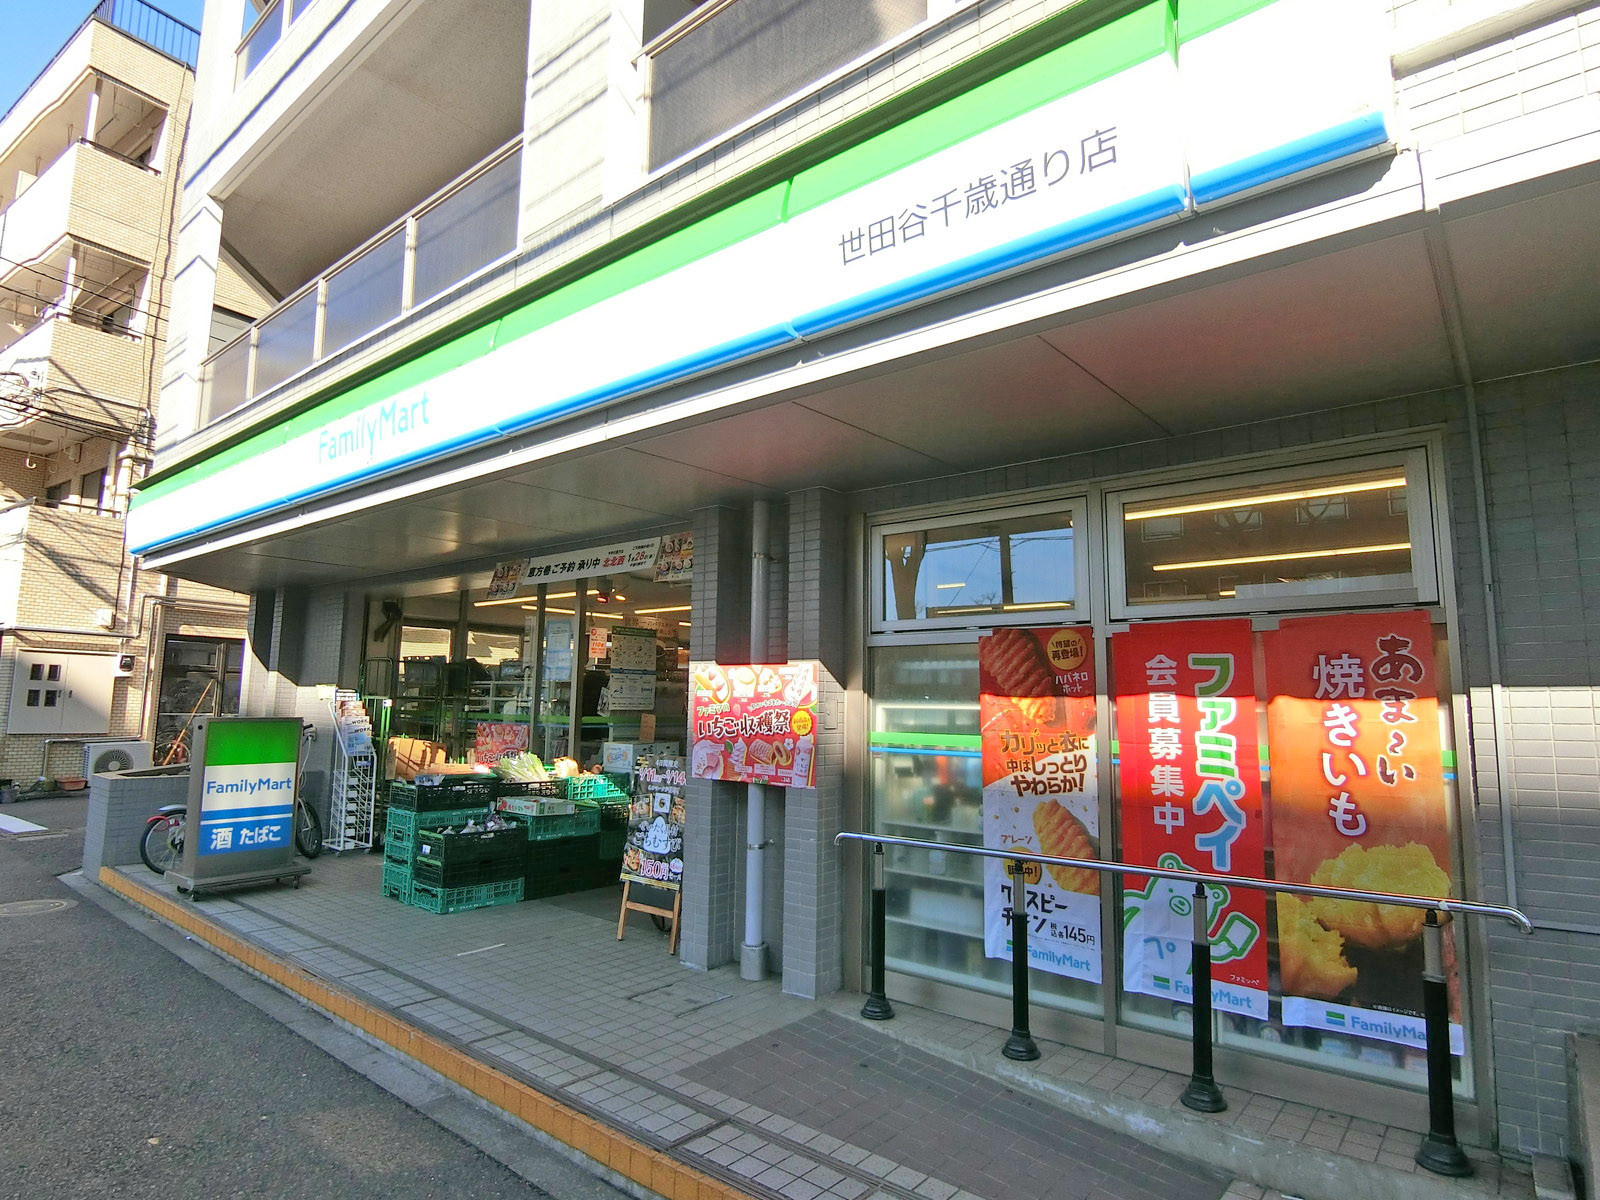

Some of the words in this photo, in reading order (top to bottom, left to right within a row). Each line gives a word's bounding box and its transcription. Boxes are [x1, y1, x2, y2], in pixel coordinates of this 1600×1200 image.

[838, 126, 1117, 266] 世田谷千歳通り店
[319, 391, 429, 464] FamilyMart
[1055, 672, 1088, 684] ハバネロ
[1063, 683, 1082, 693] ホット
[698, 710, 790, 738] いちご収穫祭
[1144, 654, 1185, 834] 会員募集中
[1312, 653, 1367, 837] 焼きいも
[1006, 755, 1086, 775] 中はしっとり
[1187, 653, 1246, 872] ファミペイ
[207, 778, 292, 794] FamilyMart
[1011, 774, 1084, 796] やわらか!
[210, 827, 234, 850] 酒
[240, 825, 281, 845] たばこ
[633, 832, 682, 852] ごちむすび
[1001, 835, 1032, 844] プレーン
[640, 858, 669, 880] 150円
[1001, 884, 1068, 914] クスピー
[1001, 907, 1047, 933] チン
[1175, 980, 1252, 1009] FayMart
[1351, 1015, 1426, 1040] FamilyMa
